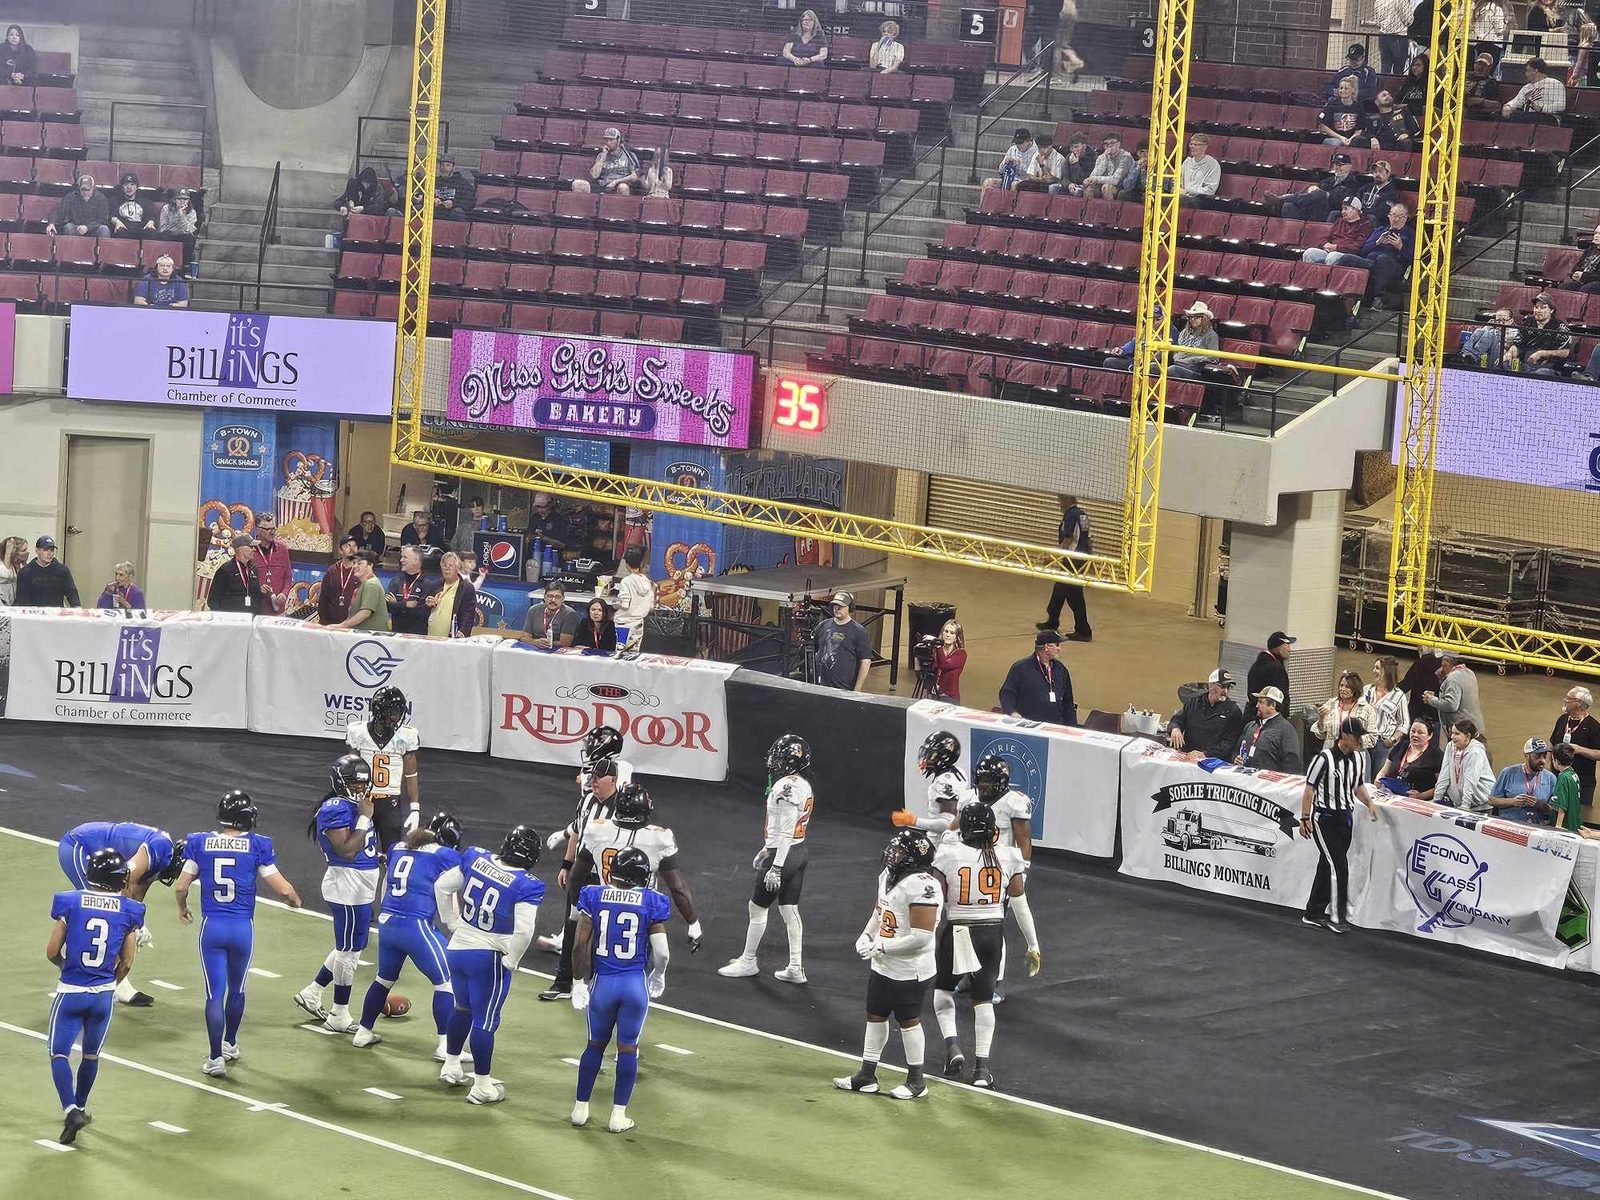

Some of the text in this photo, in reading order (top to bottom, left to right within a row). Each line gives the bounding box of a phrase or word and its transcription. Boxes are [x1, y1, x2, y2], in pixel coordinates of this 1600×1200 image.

[970, 14, 984, 35] 5
[1142, 27, 1154, 48] 3
[230, 317, 261, 347] it's
[166, 388, 297, 407] Chamber of Commerce
[460, 360, 542, 418] Miss
[635, 357, 736, 436] Sweets
[776, 380, 820, 430] 35
[548, 402, 642, 426] BAKERY
[219, 427, 258, 439] B-TOWN
[670, 465, 705, 477] B-TOWN
[482, 541, 491, 566] pepsi
[121, 629, 153, 661] it's
[324, 693, 413, 715] WESTN
[597, 687, 622, 697] THE
[55, 704, 192, 721] Chamber of Commerce
[372, 753, 391, 787] 6
[990, 744, 1037, 777] URIE LEE
[1168, 784, 1281, 821] SORLIE TRUCKING INC.
[206, 838, 248, 850] HARKER
[1411, 839, 1470, 876] ECONO
[213, 857, 236, 903] 5
[391, 855, 415, 897] 9
[473, 860, 512, 885] WHITESIDE
[957, 866, 1002, 906] 19
[1163, 853, 1271, 890] BILLINGS MONTANA
[83, 896, 119, 910] BROWN
[462, 876, 501, 932] 58
[603, 889, 641, 904] HARVEY
[81, 917, 109, 968] 3
[596, 909, 639, 960] 13
